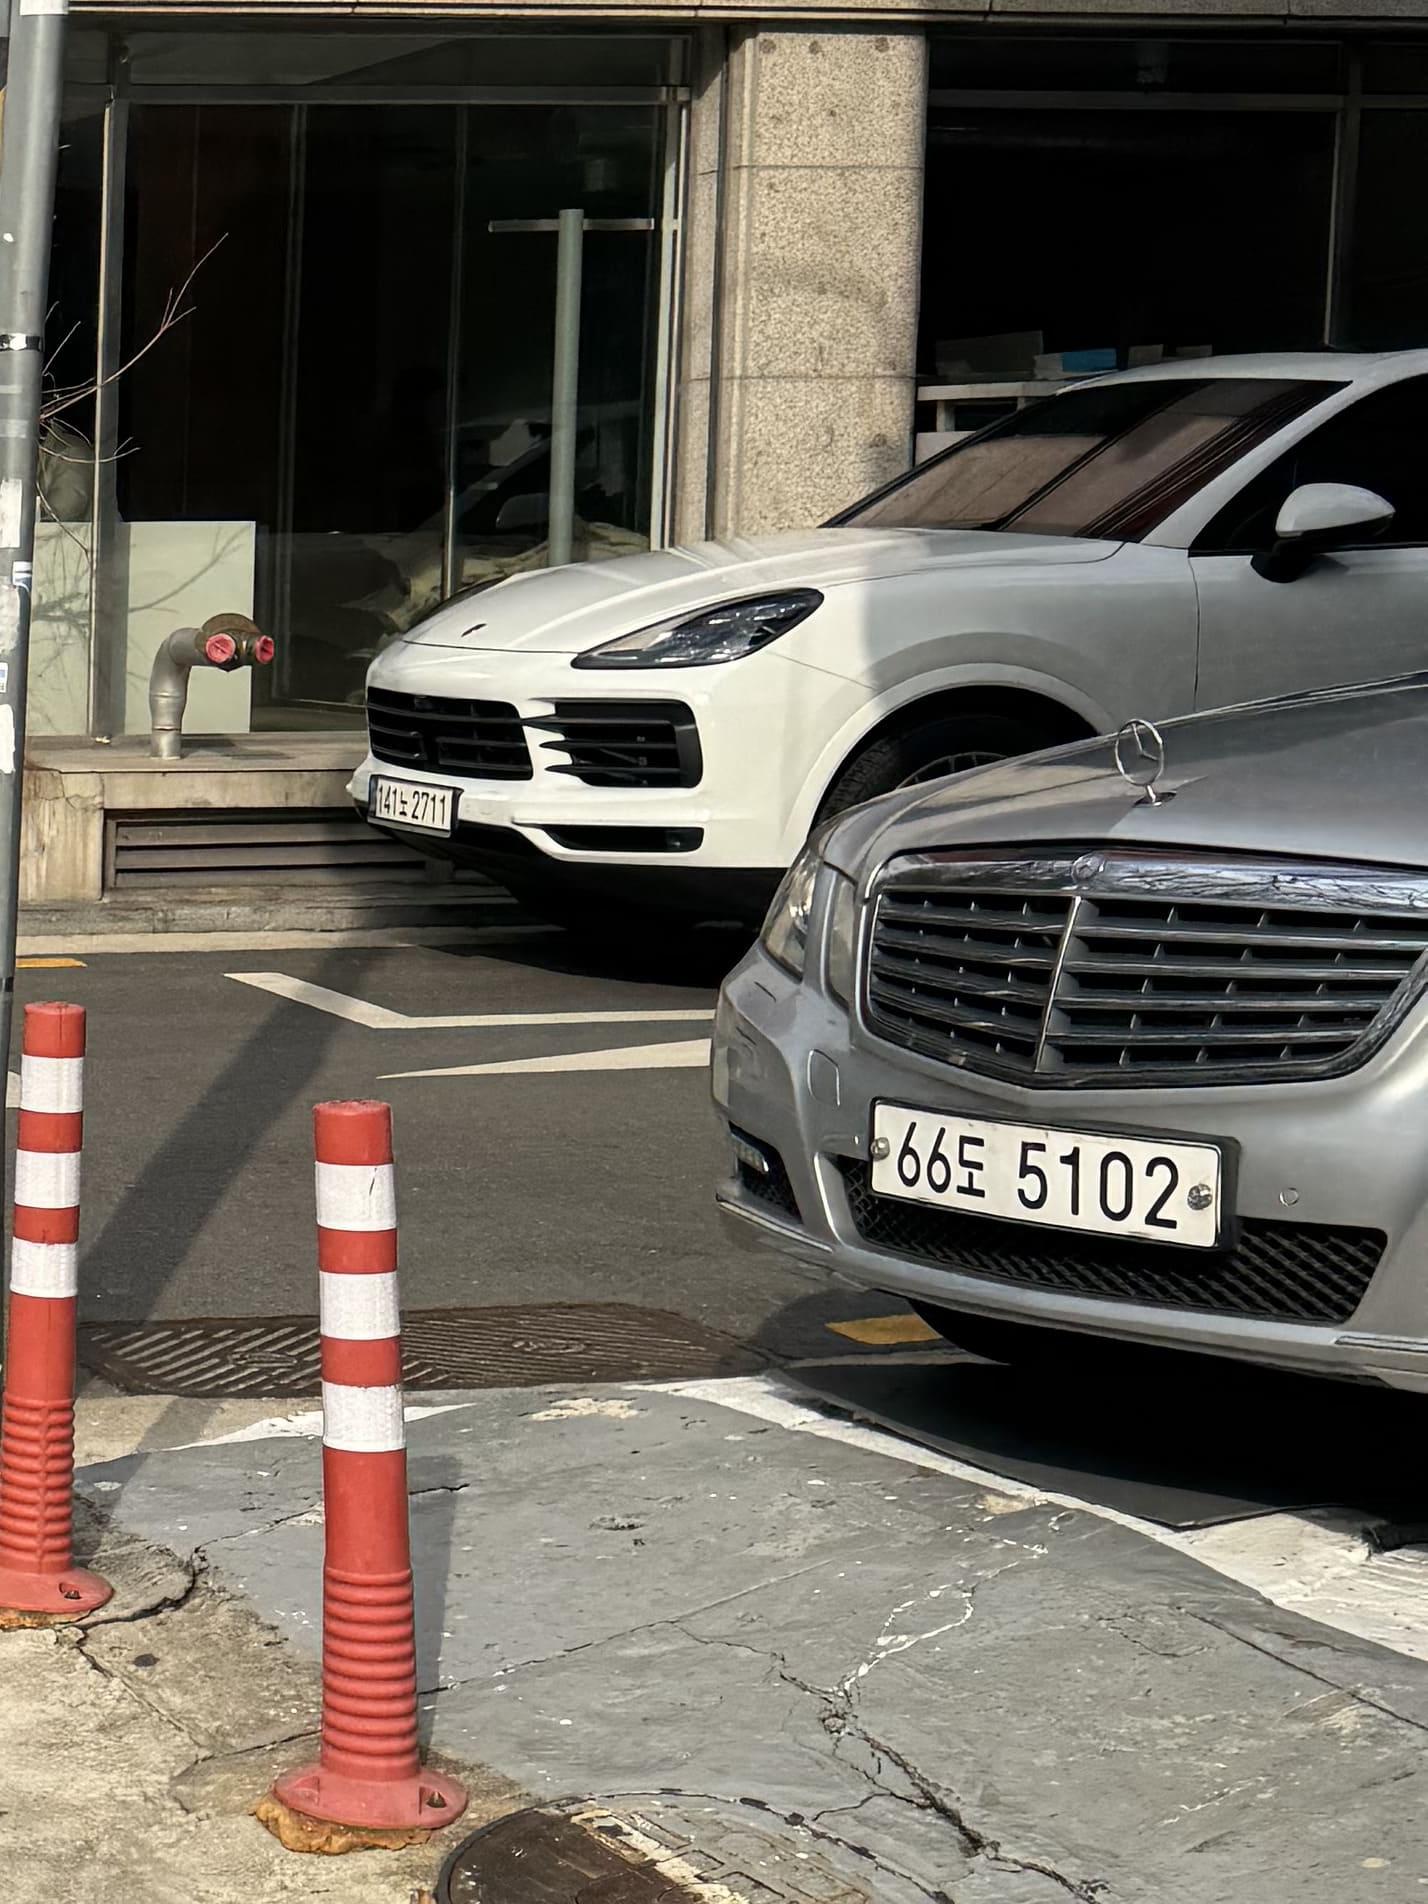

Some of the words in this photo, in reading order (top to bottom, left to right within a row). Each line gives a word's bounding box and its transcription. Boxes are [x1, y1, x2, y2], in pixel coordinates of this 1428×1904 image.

[411, 790, 446, 825] 2711
[897, 1121, 986, 1199] 66도
[1016, 1140, 1181, 1230] 5102
